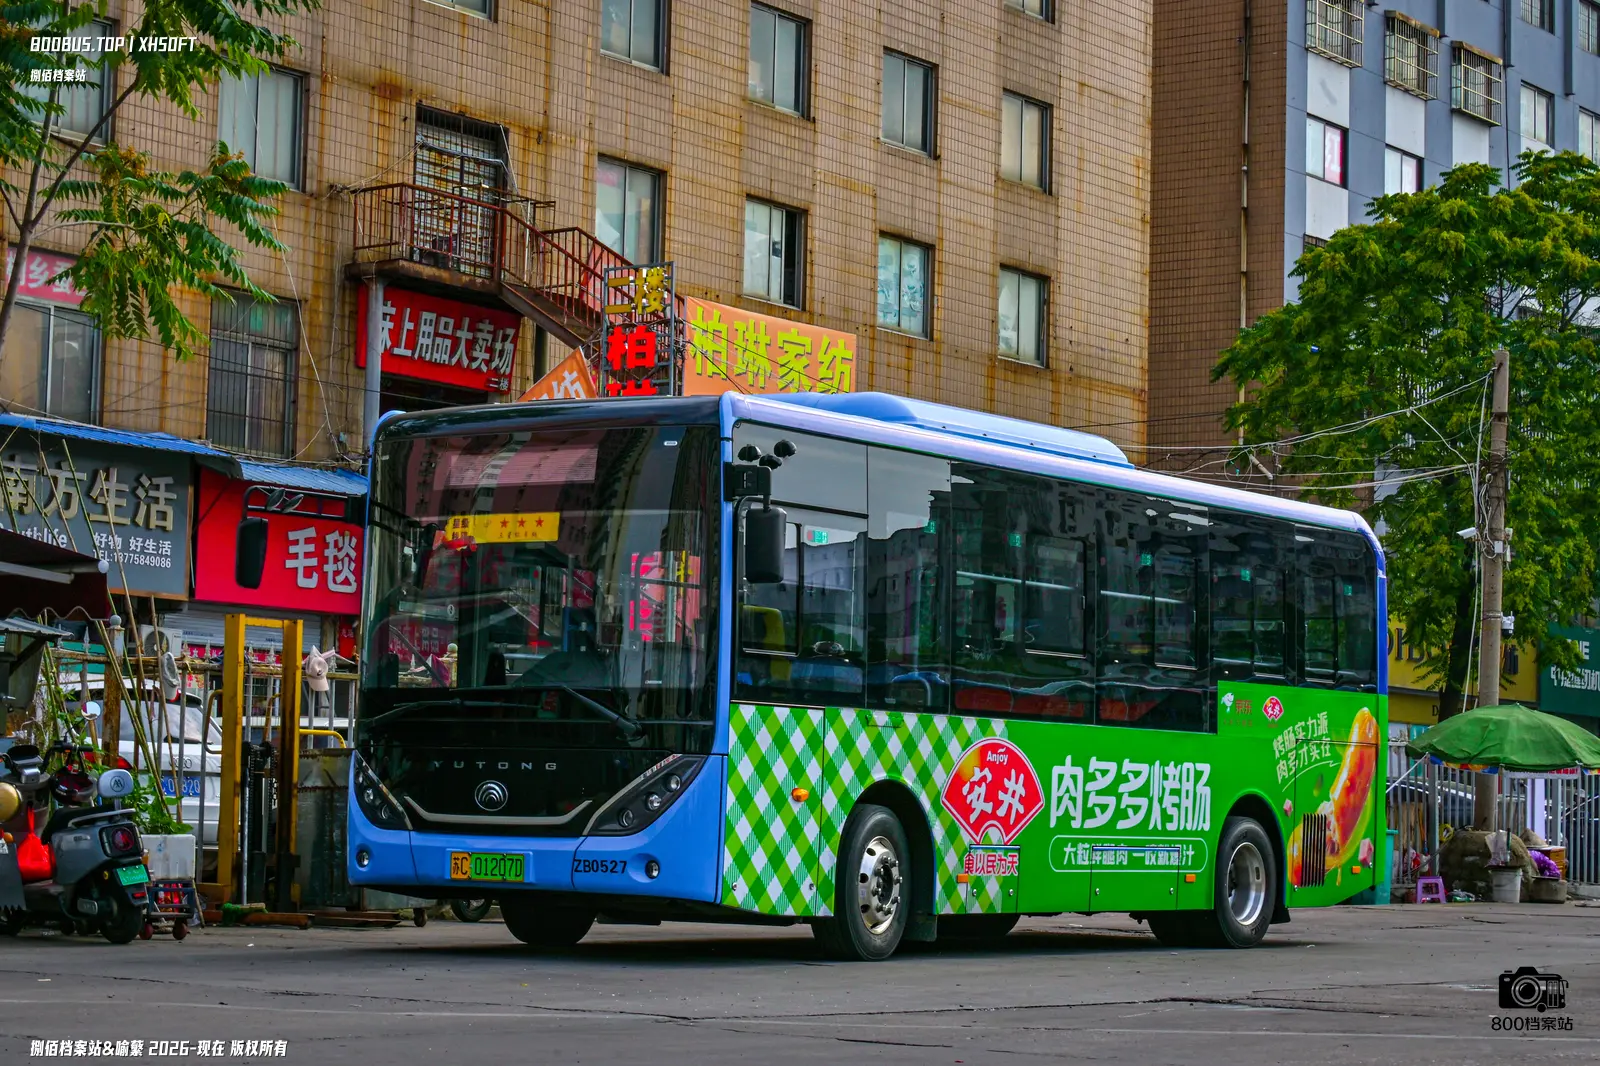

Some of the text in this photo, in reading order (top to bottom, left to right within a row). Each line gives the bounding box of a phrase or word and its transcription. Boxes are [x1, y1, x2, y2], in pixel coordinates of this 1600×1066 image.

[605, 266, 666, 316] 二楼
[689, 306, 853, 394] 柏琳家纺
[488, 377, 509, 391] 二楼
[0, 454, 178, 532] 南方生活
[94, 532, 172, 556] 好物 好生活
[285, 526, 357, 594] 毛毯
[986, 748, 1009, 765] Anjoy
[1273, 711, 1329, 760] 烤肠实力派
[1276, 735, 1331, 785] 肉多才实在
[433, 760, 557, 771] YUTONG
[962, 766, 1026, 826] 安井
[1049, 754, 1212, 832] 肉多多烤肠
[474, 856, 523, 878] 01207D
[574, 859, 627, 874] ZB0527
[963, 852, 1019, 876] 食以民为天
